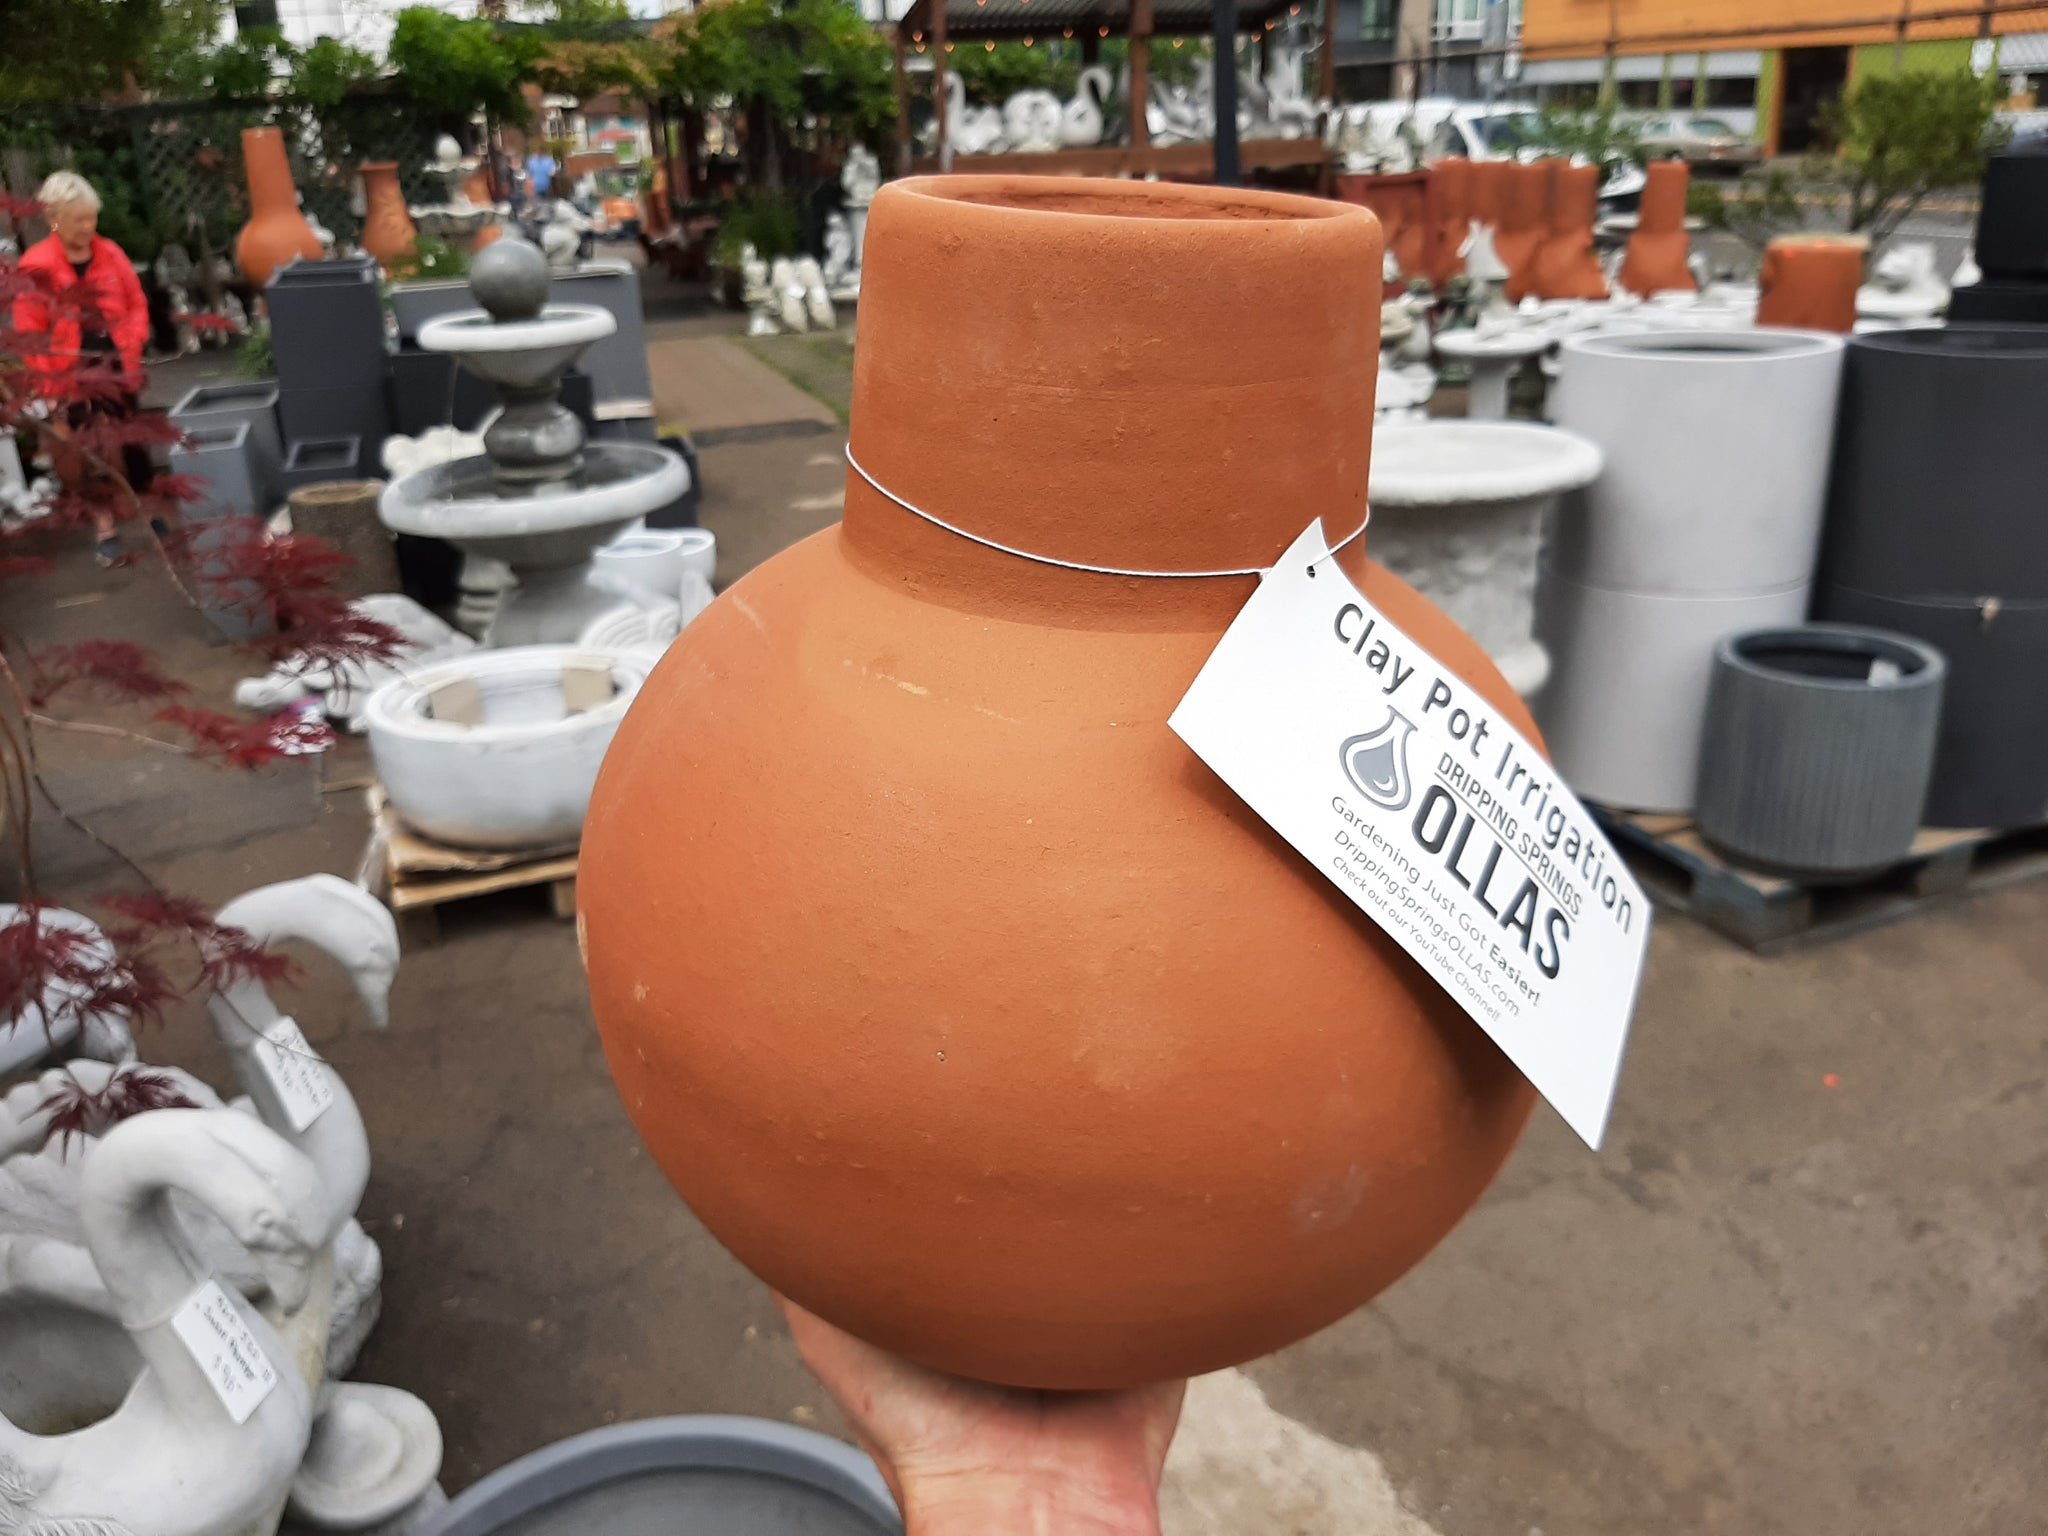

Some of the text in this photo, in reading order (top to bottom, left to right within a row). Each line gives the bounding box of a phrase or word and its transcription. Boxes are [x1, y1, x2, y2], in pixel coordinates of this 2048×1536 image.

[1334, 603, 1632, 935] Clay Pot Irrigation
[1437, 752, 1582, 915] DRIPPING SPRINGS
[1332, 796, 1540, 1007] Gardening Just Got Easier!
[1333, 857, 1367, 891] Check
[1368, 889, 1389, 910] out
[1388, 909, 1409, 928] our
[1408, 924, 1455, 974] YouTube
[1334, 830, 1519, 1017] DrippingSpringsOLLAS.com
[1412, 784, 1570, 979] OLLAS
